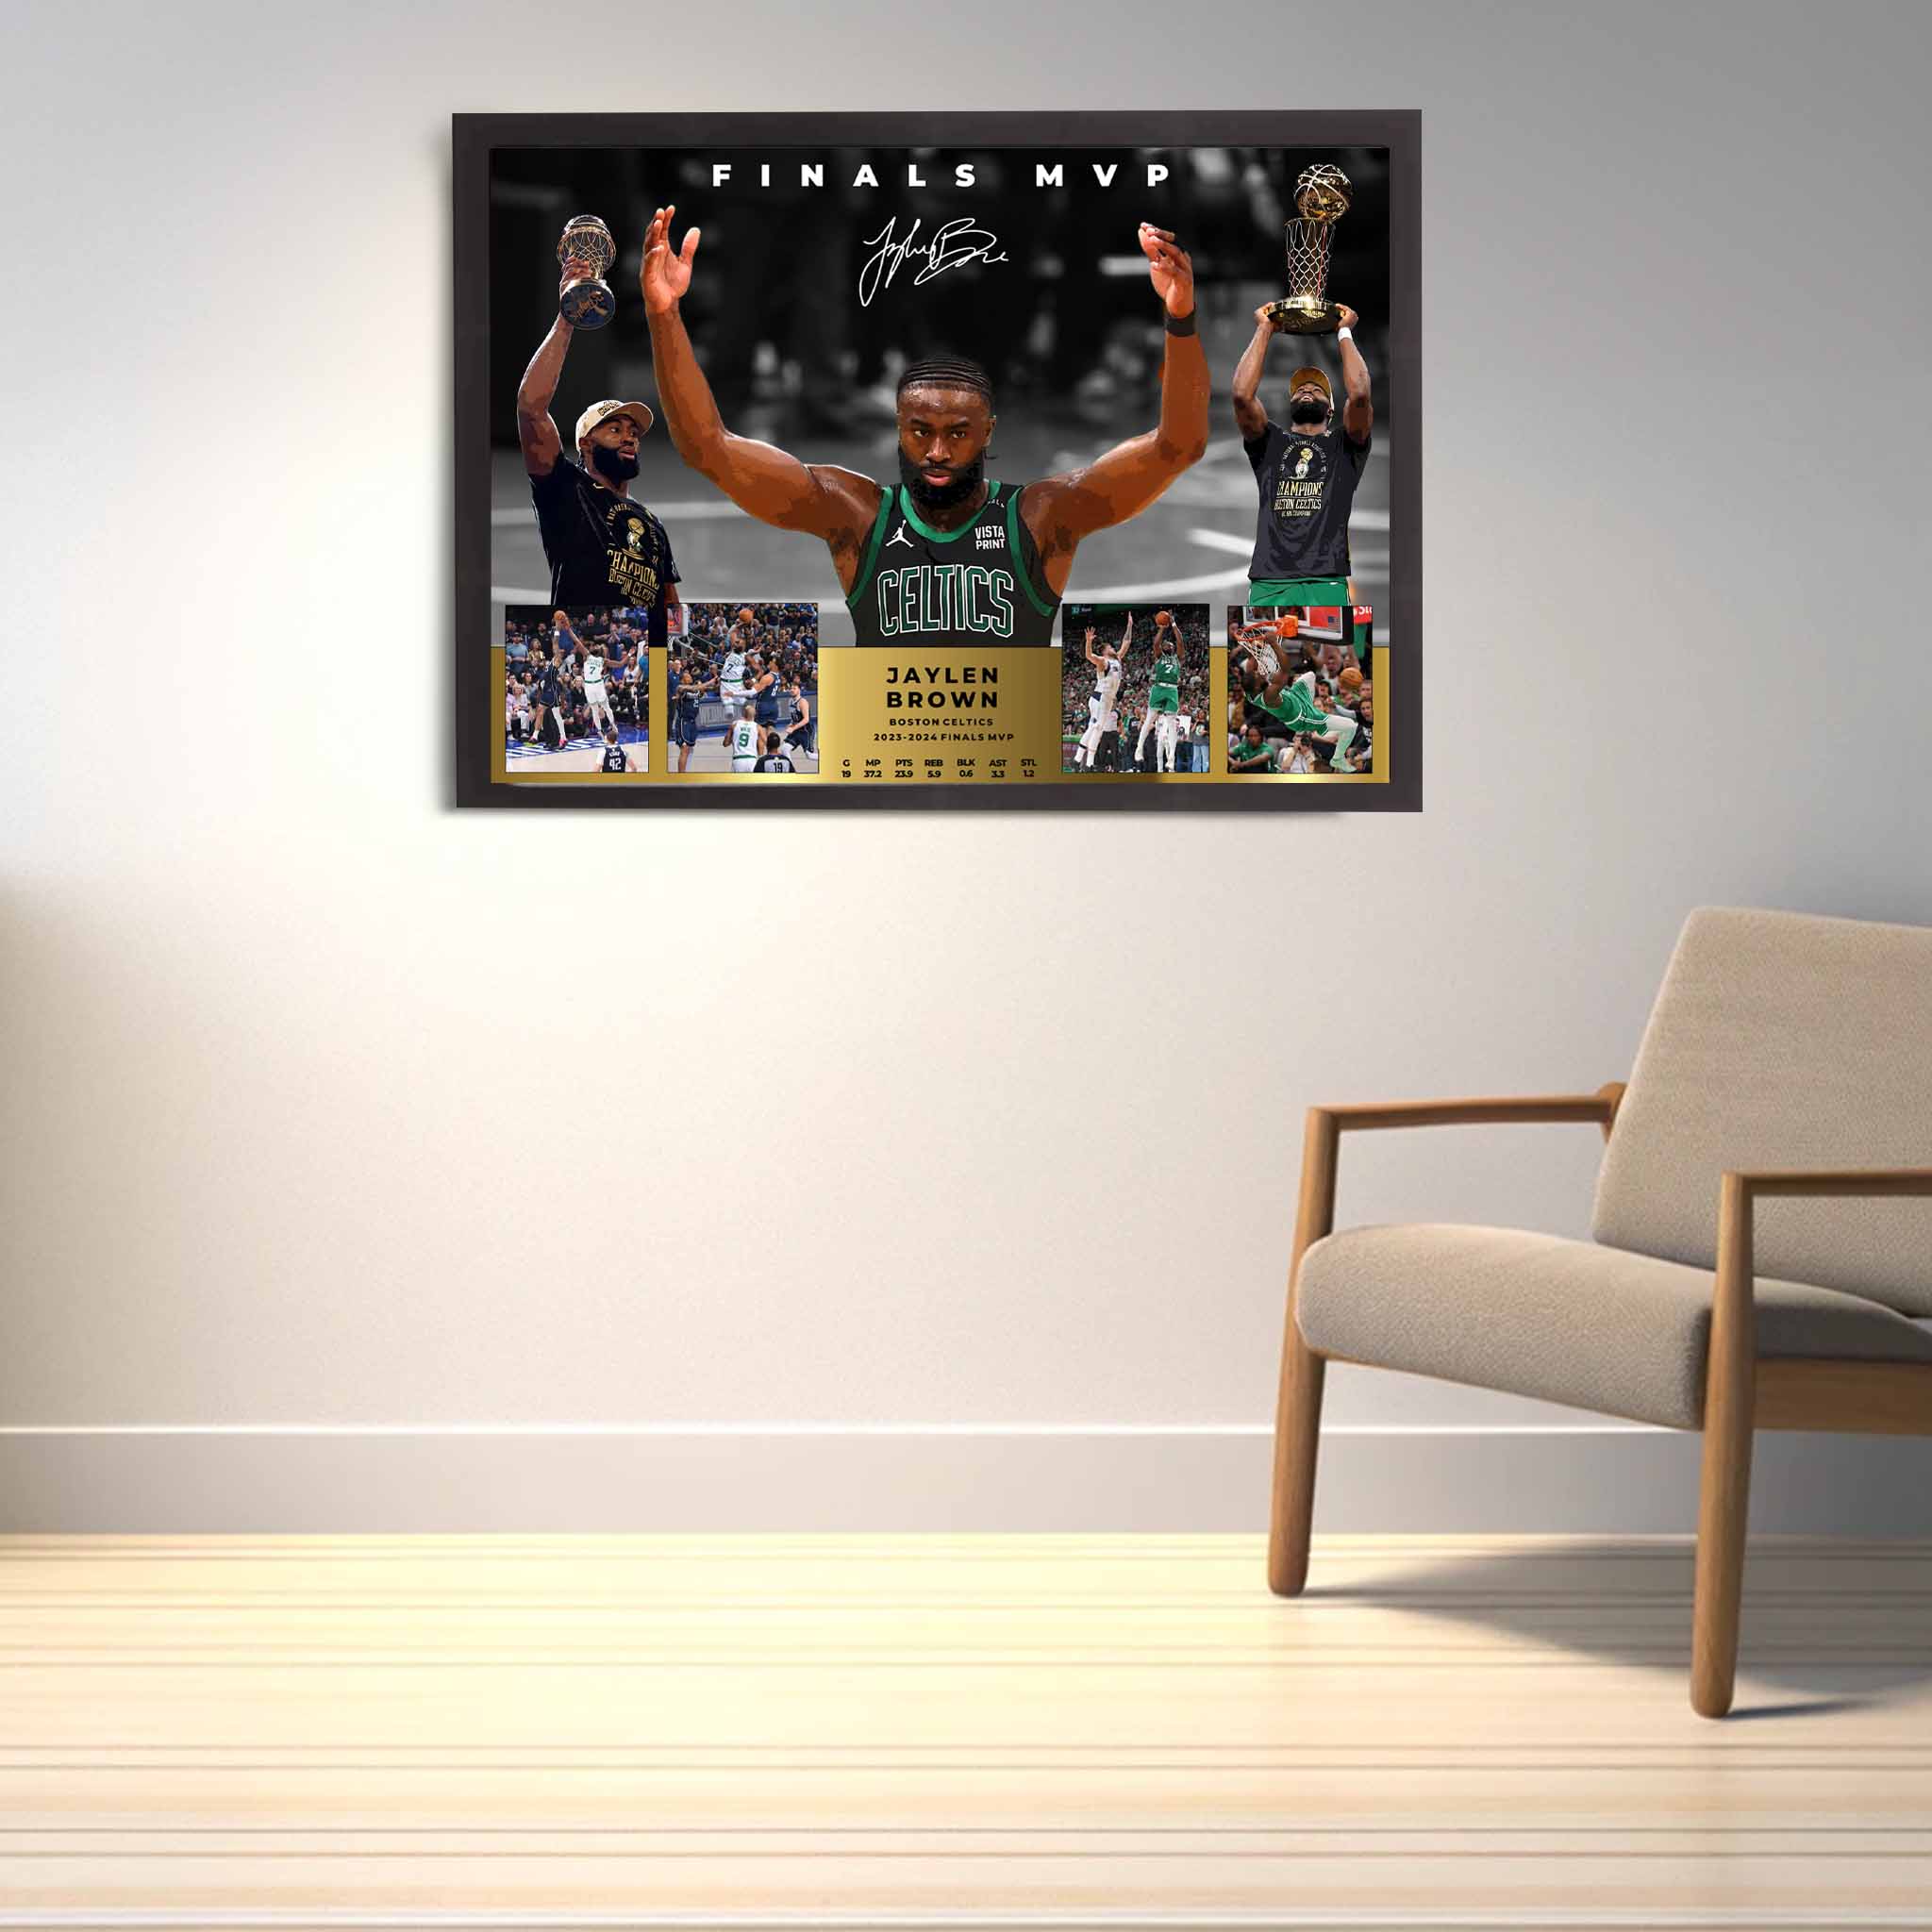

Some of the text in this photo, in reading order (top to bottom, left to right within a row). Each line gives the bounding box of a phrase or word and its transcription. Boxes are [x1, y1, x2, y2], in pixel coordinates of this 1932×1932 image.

[712, 164, 1169, 188] FINALS MVP
[974, 525, 1006, 540] VISTA
[975, 538, 1007, 550] PRINT
[877, 564, 1014, 638] CELTICS
[590, 666, 596, 675] 7
[1165, 664, 1174, 674] 7
[886, 667, 998, 684] JAYLEN
[887, 691, 998, 708] BROWN
[890, 718, 993, 726] BOSTON CELTICS
[739, 733, 750, 747] 9
[874, 733, 1014, 741] 2023-2024 FINALS MVP
[608, 758, 622, 771] 42
[957, 758, 975, 767] BLK
[1021, 758, 1037, 767] STL
[841, 769, 1035, 778] 19 37.2 23.9 5.9 0.6 3.3 1.2
